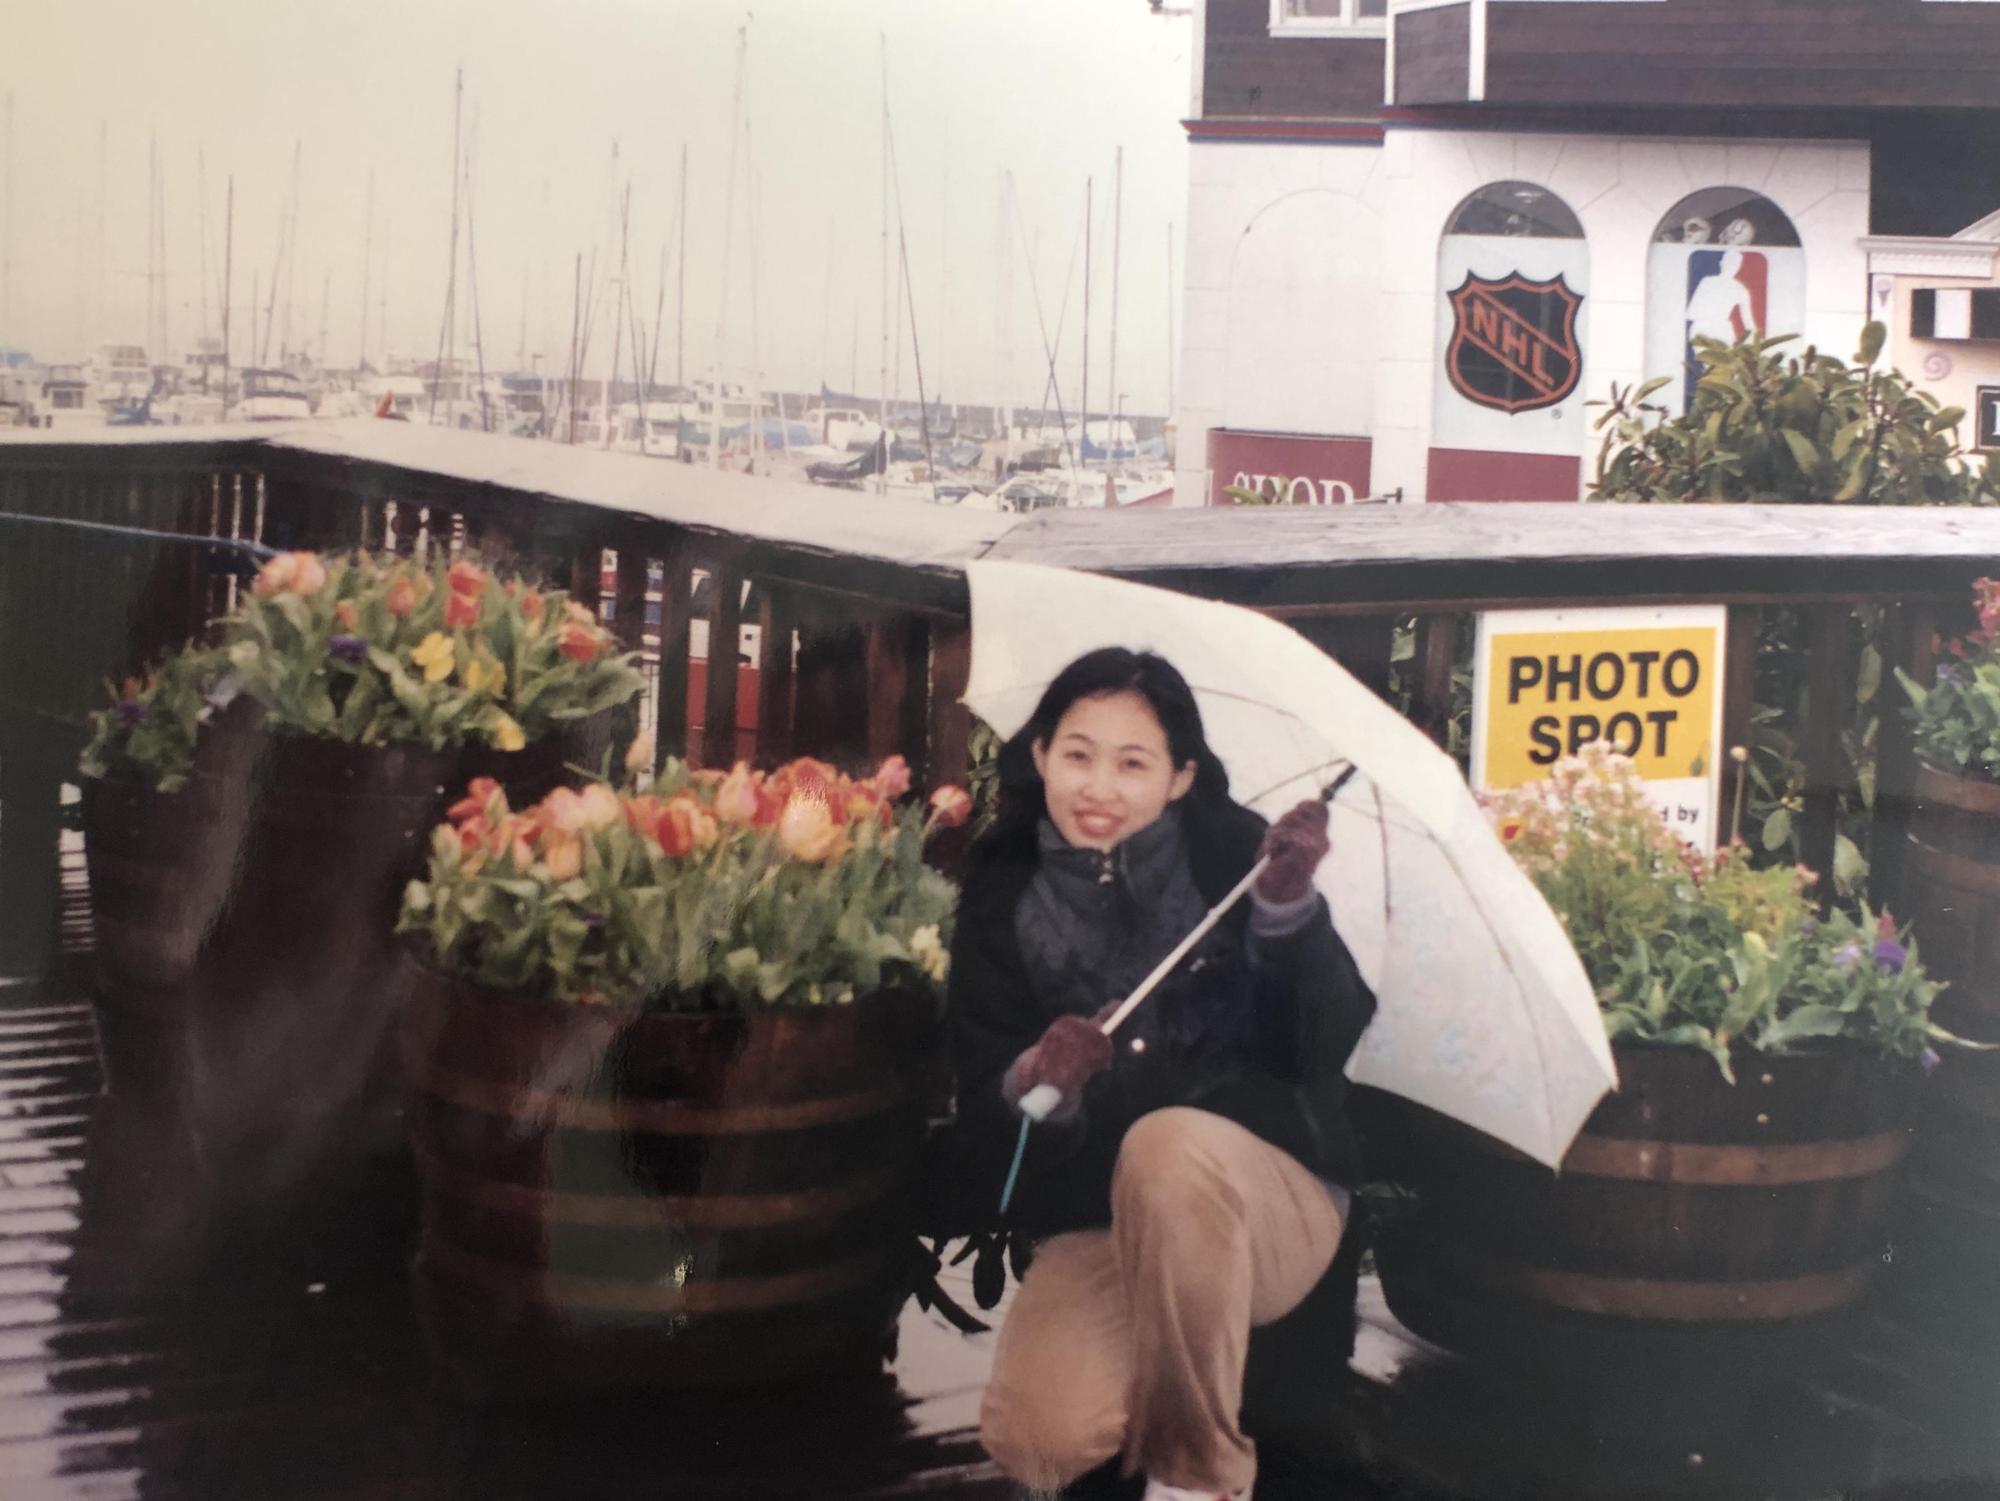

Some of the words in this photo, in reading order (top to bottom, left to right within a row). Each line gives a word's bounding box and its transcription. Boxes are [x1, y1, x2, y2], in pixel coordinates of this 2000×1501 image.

[1473, 299, 1555, 387] NHL
[1508, 649, 1699, 704] PHOTO
[1527, 710, 1677, 764] SPOT
[1677, 804, 1699, 824] by
